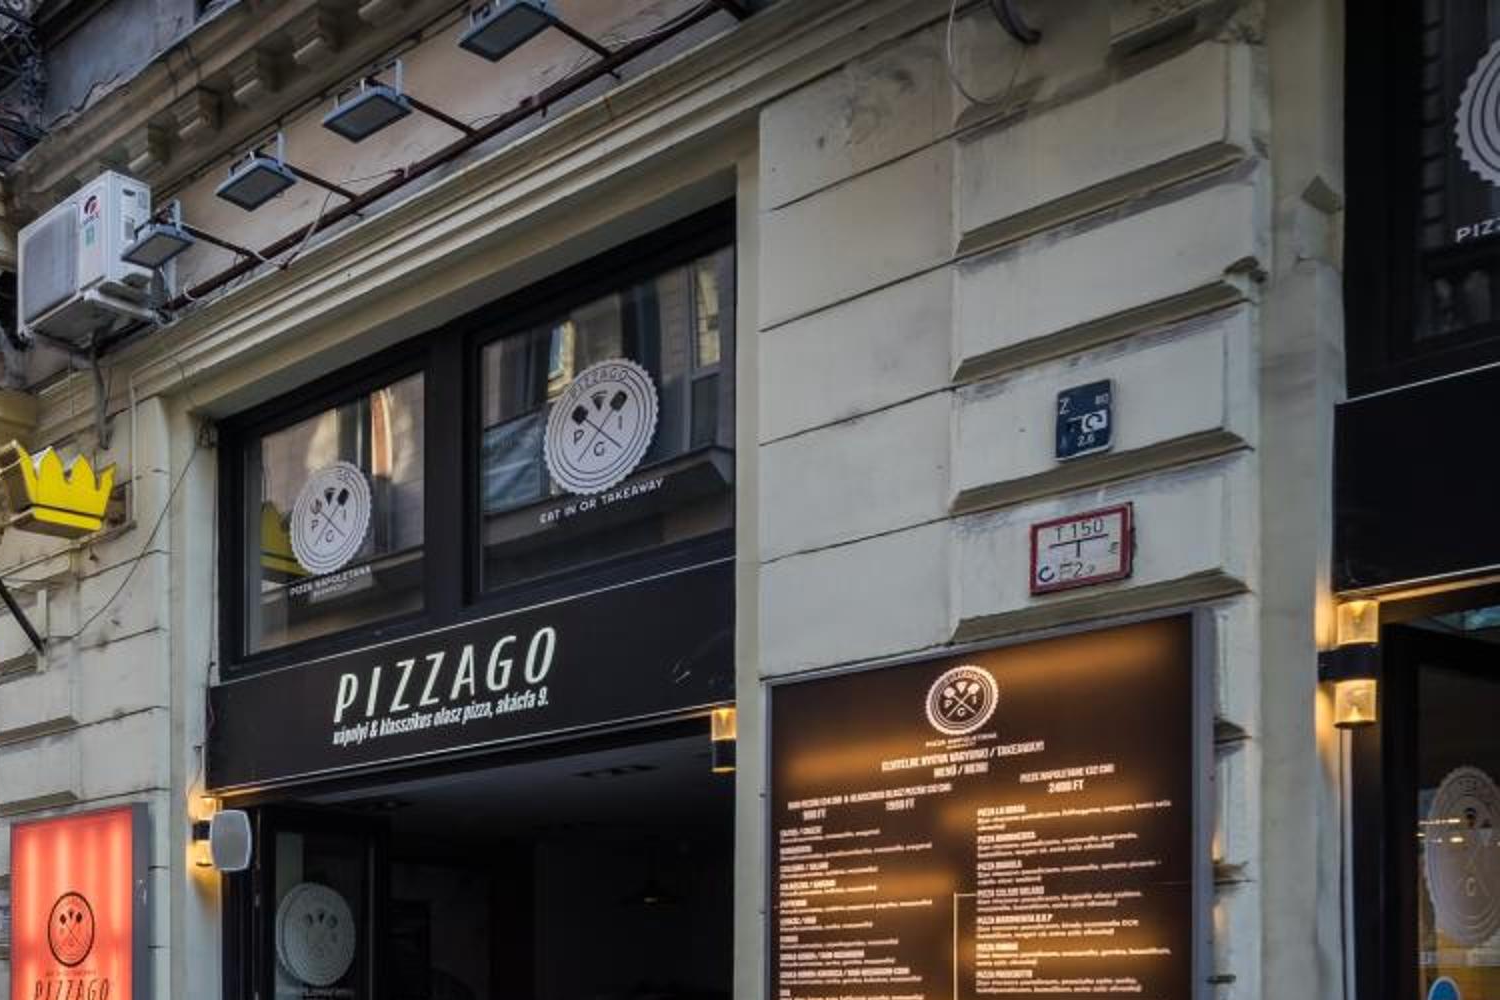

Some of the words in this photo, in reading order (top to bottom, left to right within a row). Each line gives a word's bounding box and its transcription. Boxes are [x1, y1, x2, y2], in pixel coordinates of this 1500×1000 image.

[539, 508, 561, 524] EAT
[563, 502, 577, 518] IN
[579, 497, 597, 512] OR
[601, 478, 664, 505] TAKEAWAY
[333, 626, 557, 723] PIZZAGO
[379, 712, 432, 736] klasszikus
[433, 706, 462, 726] olasz
